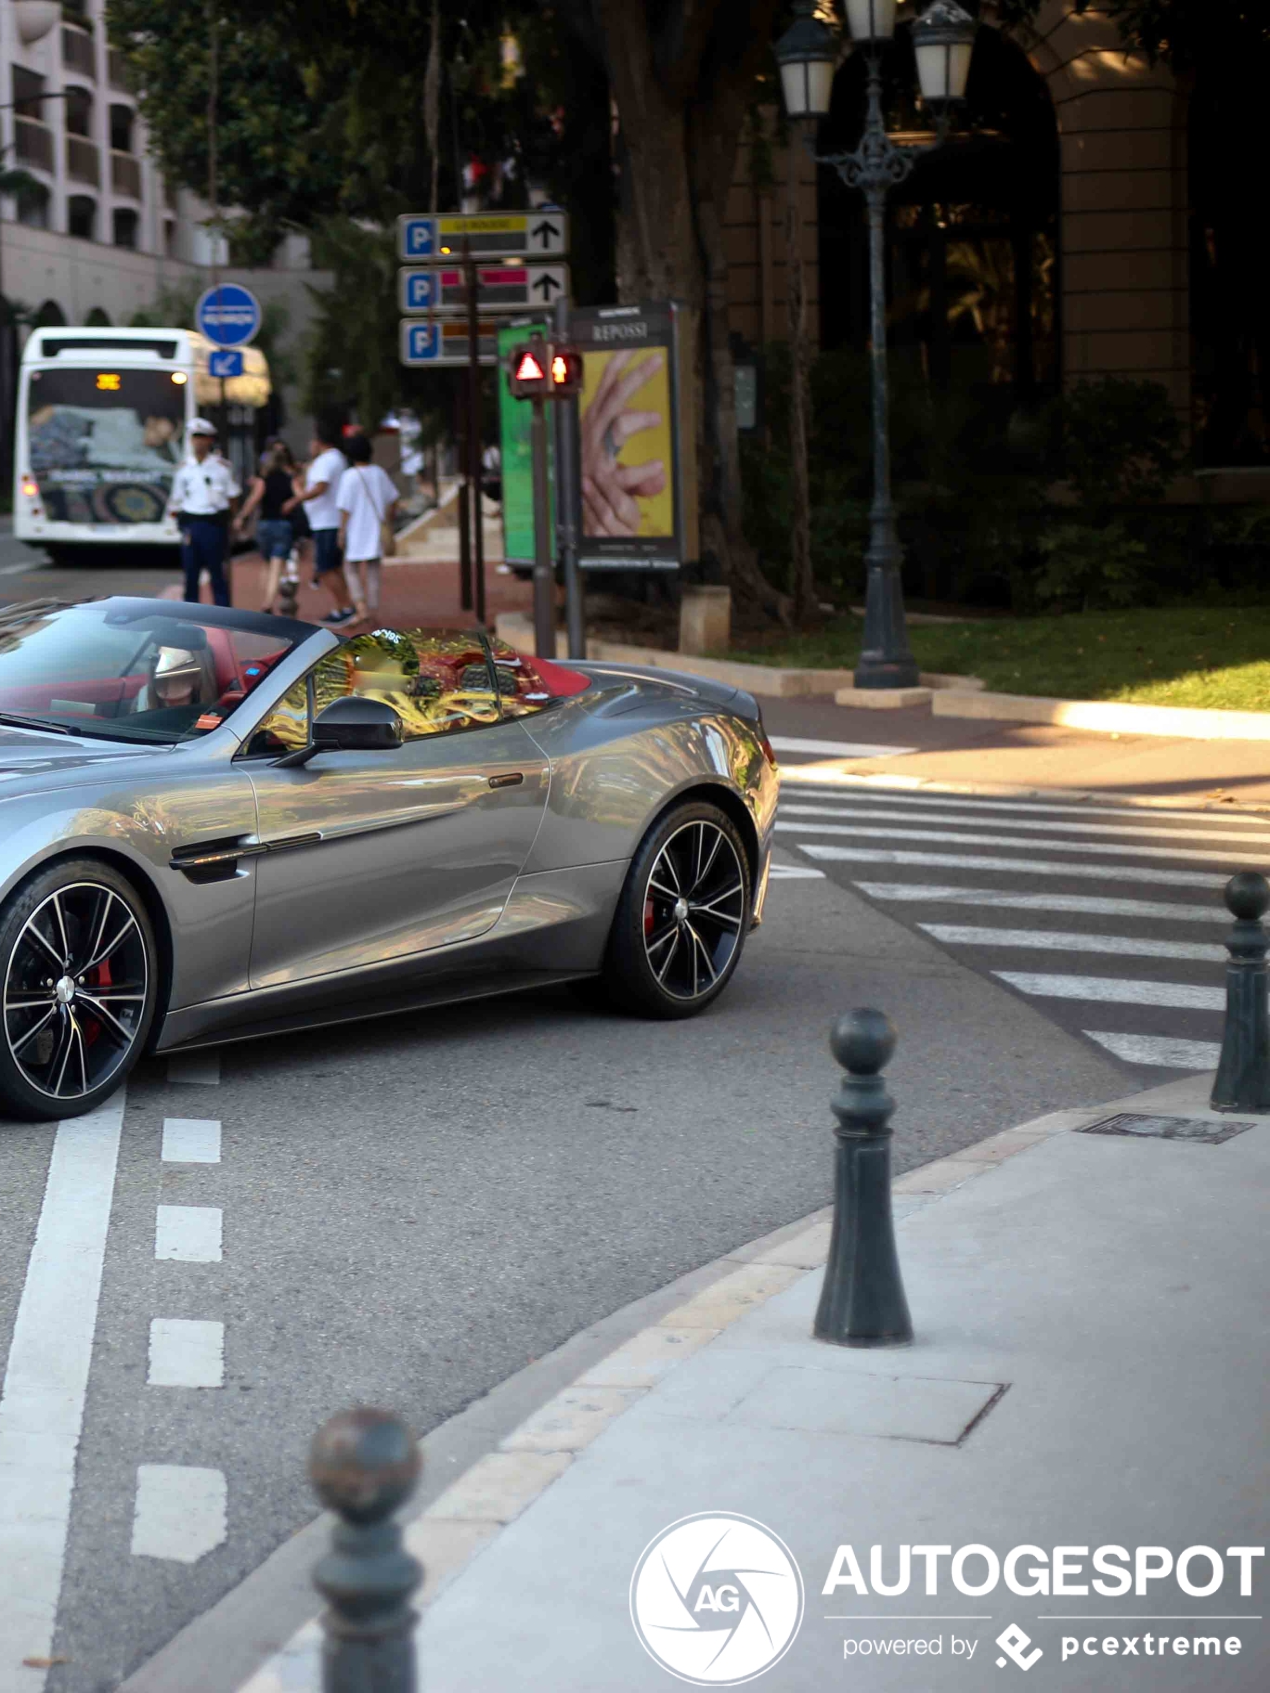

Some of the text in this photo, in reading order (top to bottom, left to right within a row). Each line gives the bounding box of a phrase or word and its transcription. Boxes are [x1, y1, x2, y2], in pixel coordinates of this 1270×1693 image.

[412, 227, 430, 249] P
[413, 279, 432, 302] P
[593, 322, 647, 341] REPOSSI
